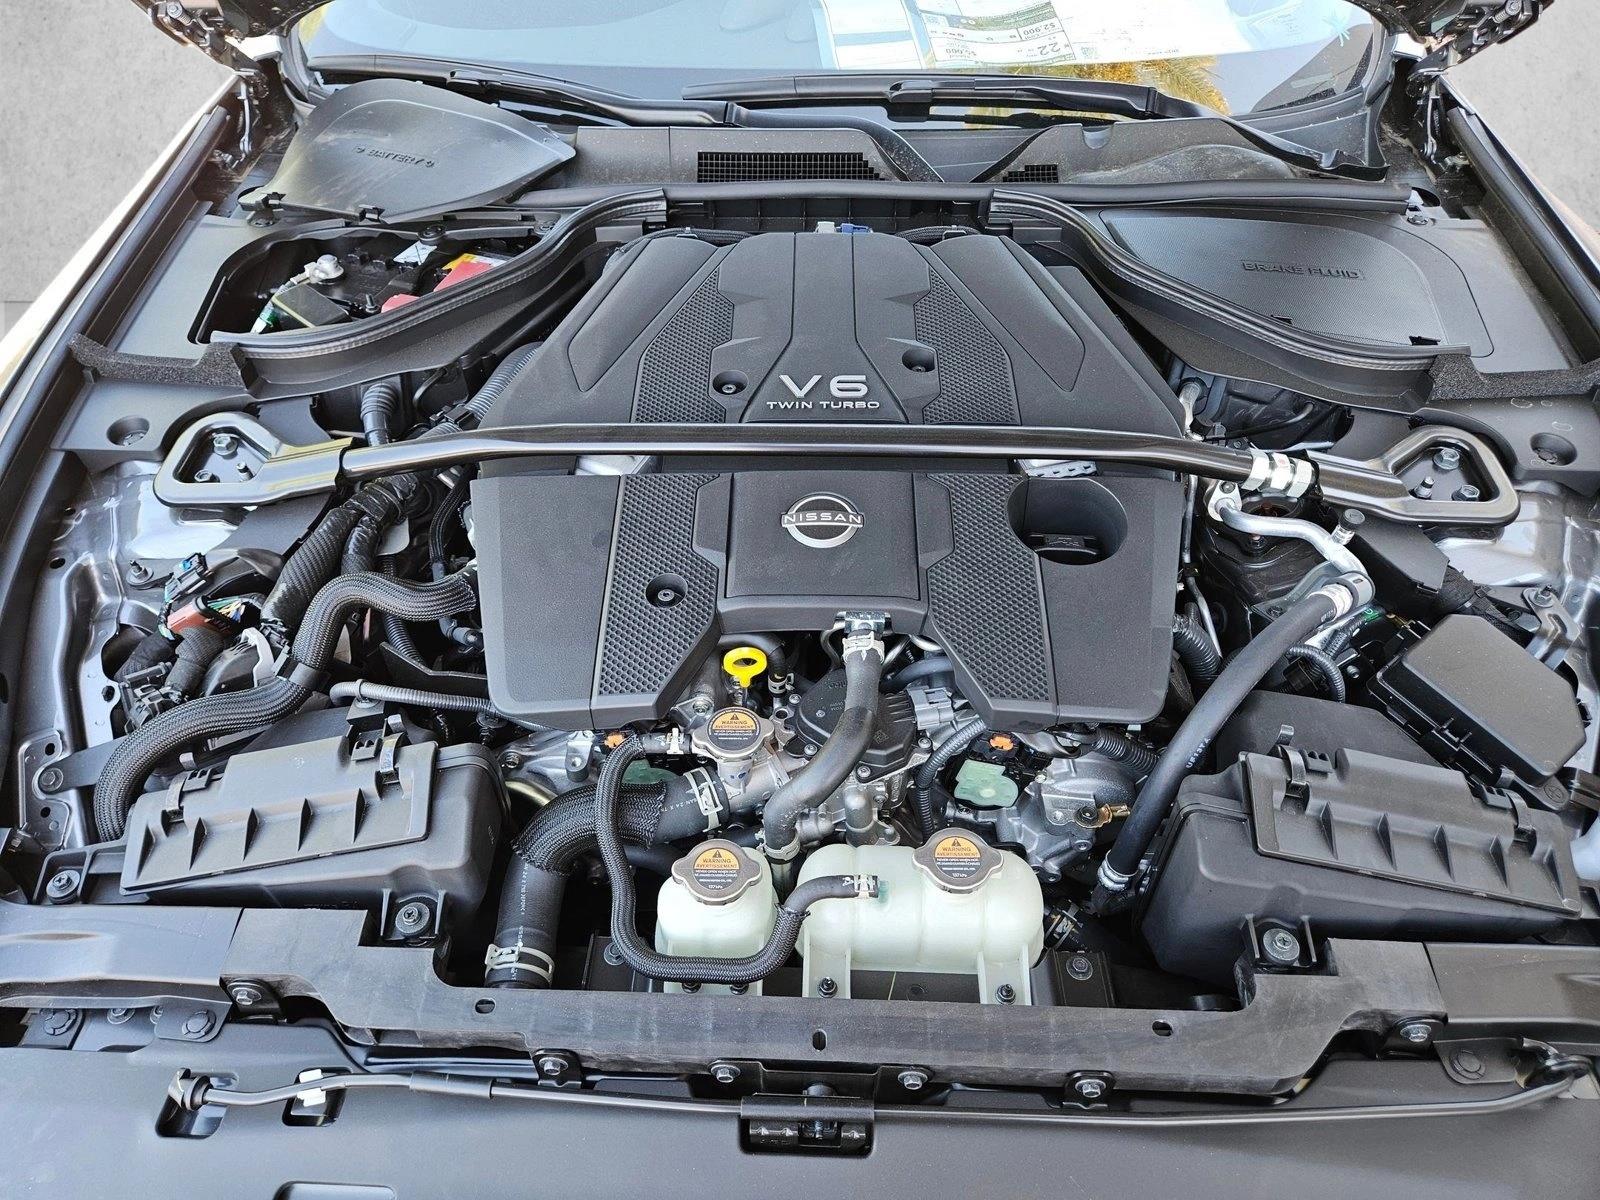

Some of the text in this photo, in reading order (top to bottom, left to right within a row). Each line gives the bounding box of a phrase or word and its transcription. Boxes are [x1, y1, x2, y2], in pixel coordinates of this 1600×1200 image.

[1037, 42, 1061, 56] 22
[368, 149, 425, 165] BATTERY
[1242, 262, 1360, 279] BRAKE FLUID
[779, 374, 868, 398] V6
[766, 401, 880, 409] TWIN TURBO
[784, 512, 861, 524] NISSAN
